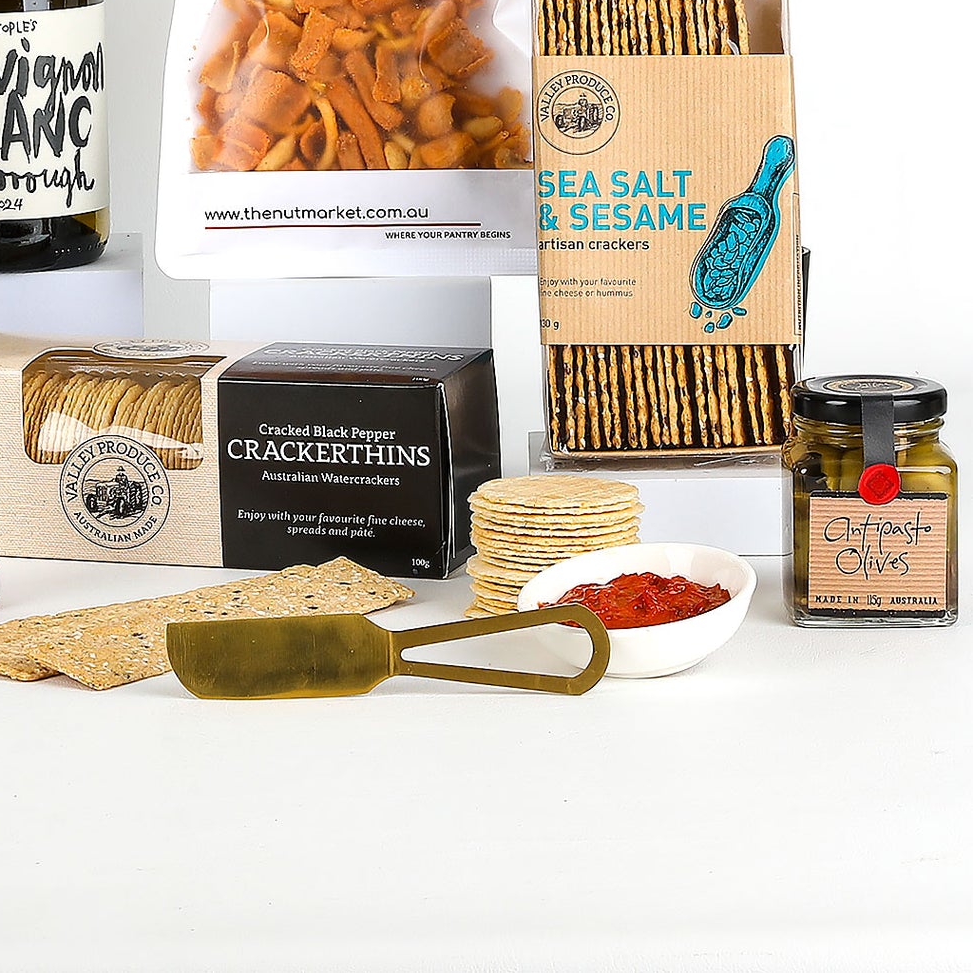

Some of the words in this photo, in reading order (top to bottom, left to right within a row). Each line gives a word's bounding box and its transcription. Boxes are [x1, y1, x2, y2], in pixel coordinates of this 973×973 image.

[540, 78, 564, 122] VALLEY
[565, 74, 614, 105] PRODUCE
[538, 170, 601, 198] SEA
[610, 170, 692, 198] SALT
[204, 206, 429, 221] www.thenutmarket.com.au
[539, 203, 559, 231] &
[569, 203, 707, 231] SESAME
[385, 231, 416, 240] WHERE
[417, 231, 442, 239] YOUR
[443, 231, 478, 239] PANTRY
[480, 230, 511, 239] BEGINS
[538, 238, 584, 250] artisan
[588, 238, 650, 250] crackers
[580, 279, 598, 287] your
[258, 423, 310, 437] Cracked
[313, 425, 349, 439] Black
[350, 427, 396, 443] Pepper
[227, 438, 431, 467] CRACKERTHINS
[65, 445, 96, 502] VALLEY
[97, 440, 161, 482] PRODUCE
[261, 470, 319, 484] Australian
[320, 472, 400, 487] Watercrackers
[74, 511, 132, 543] AUSTRALIAN
[133, 515, 158, 539] MADE
[237, 509, 267, 522] Enjoy
[268, 511, 291, 522] with
[292, 513, 317, 524] your
[317, 512, 367, 526] favourite
[366, 514, 388, 527] fine
[389, 515, 426, 528] cheese,
[287, 525, 326, 536] spreads
[328, 525, 348, 536] and
[411, 558, 430, 569] 100g
[835, 544, 910, 580] Olives
[815, 595, 842, 604] MADE
[846, 595, 859, 604] IN
[890, 595, 939, 605] AUSTRALIA
